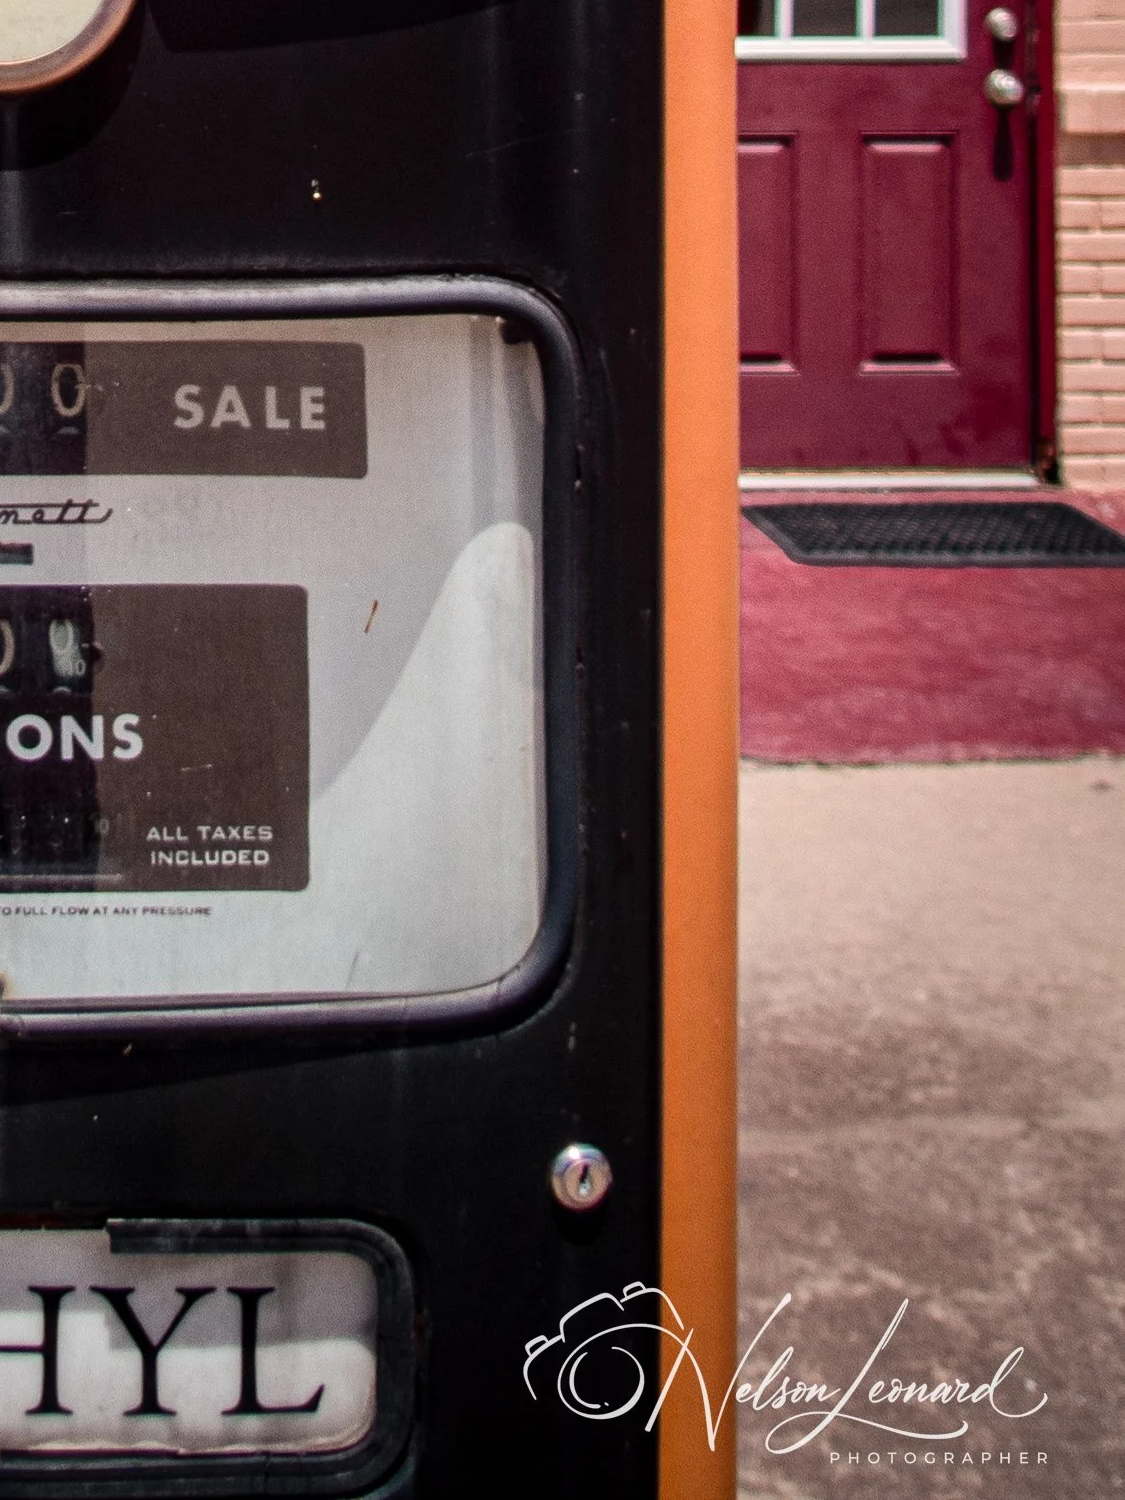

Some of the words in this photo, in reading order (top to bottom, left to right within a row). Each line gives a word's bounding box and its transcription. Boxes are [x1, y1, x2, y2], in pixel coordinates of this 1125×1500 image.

[172, 382, 328, 432] SALE
[146, 825, 189, 842] ALL
[196, 825, 274, 842] TAXES
[149, 849, 271, 867] INCLUDED
[15, 906, 48, 916] FULL
[50, 906, 90, 916] FLOW
[92, 906, 109, 916] AT
[112, 906, 138, 916] ANY
[142, 906, 213, 917] PRESSURE
